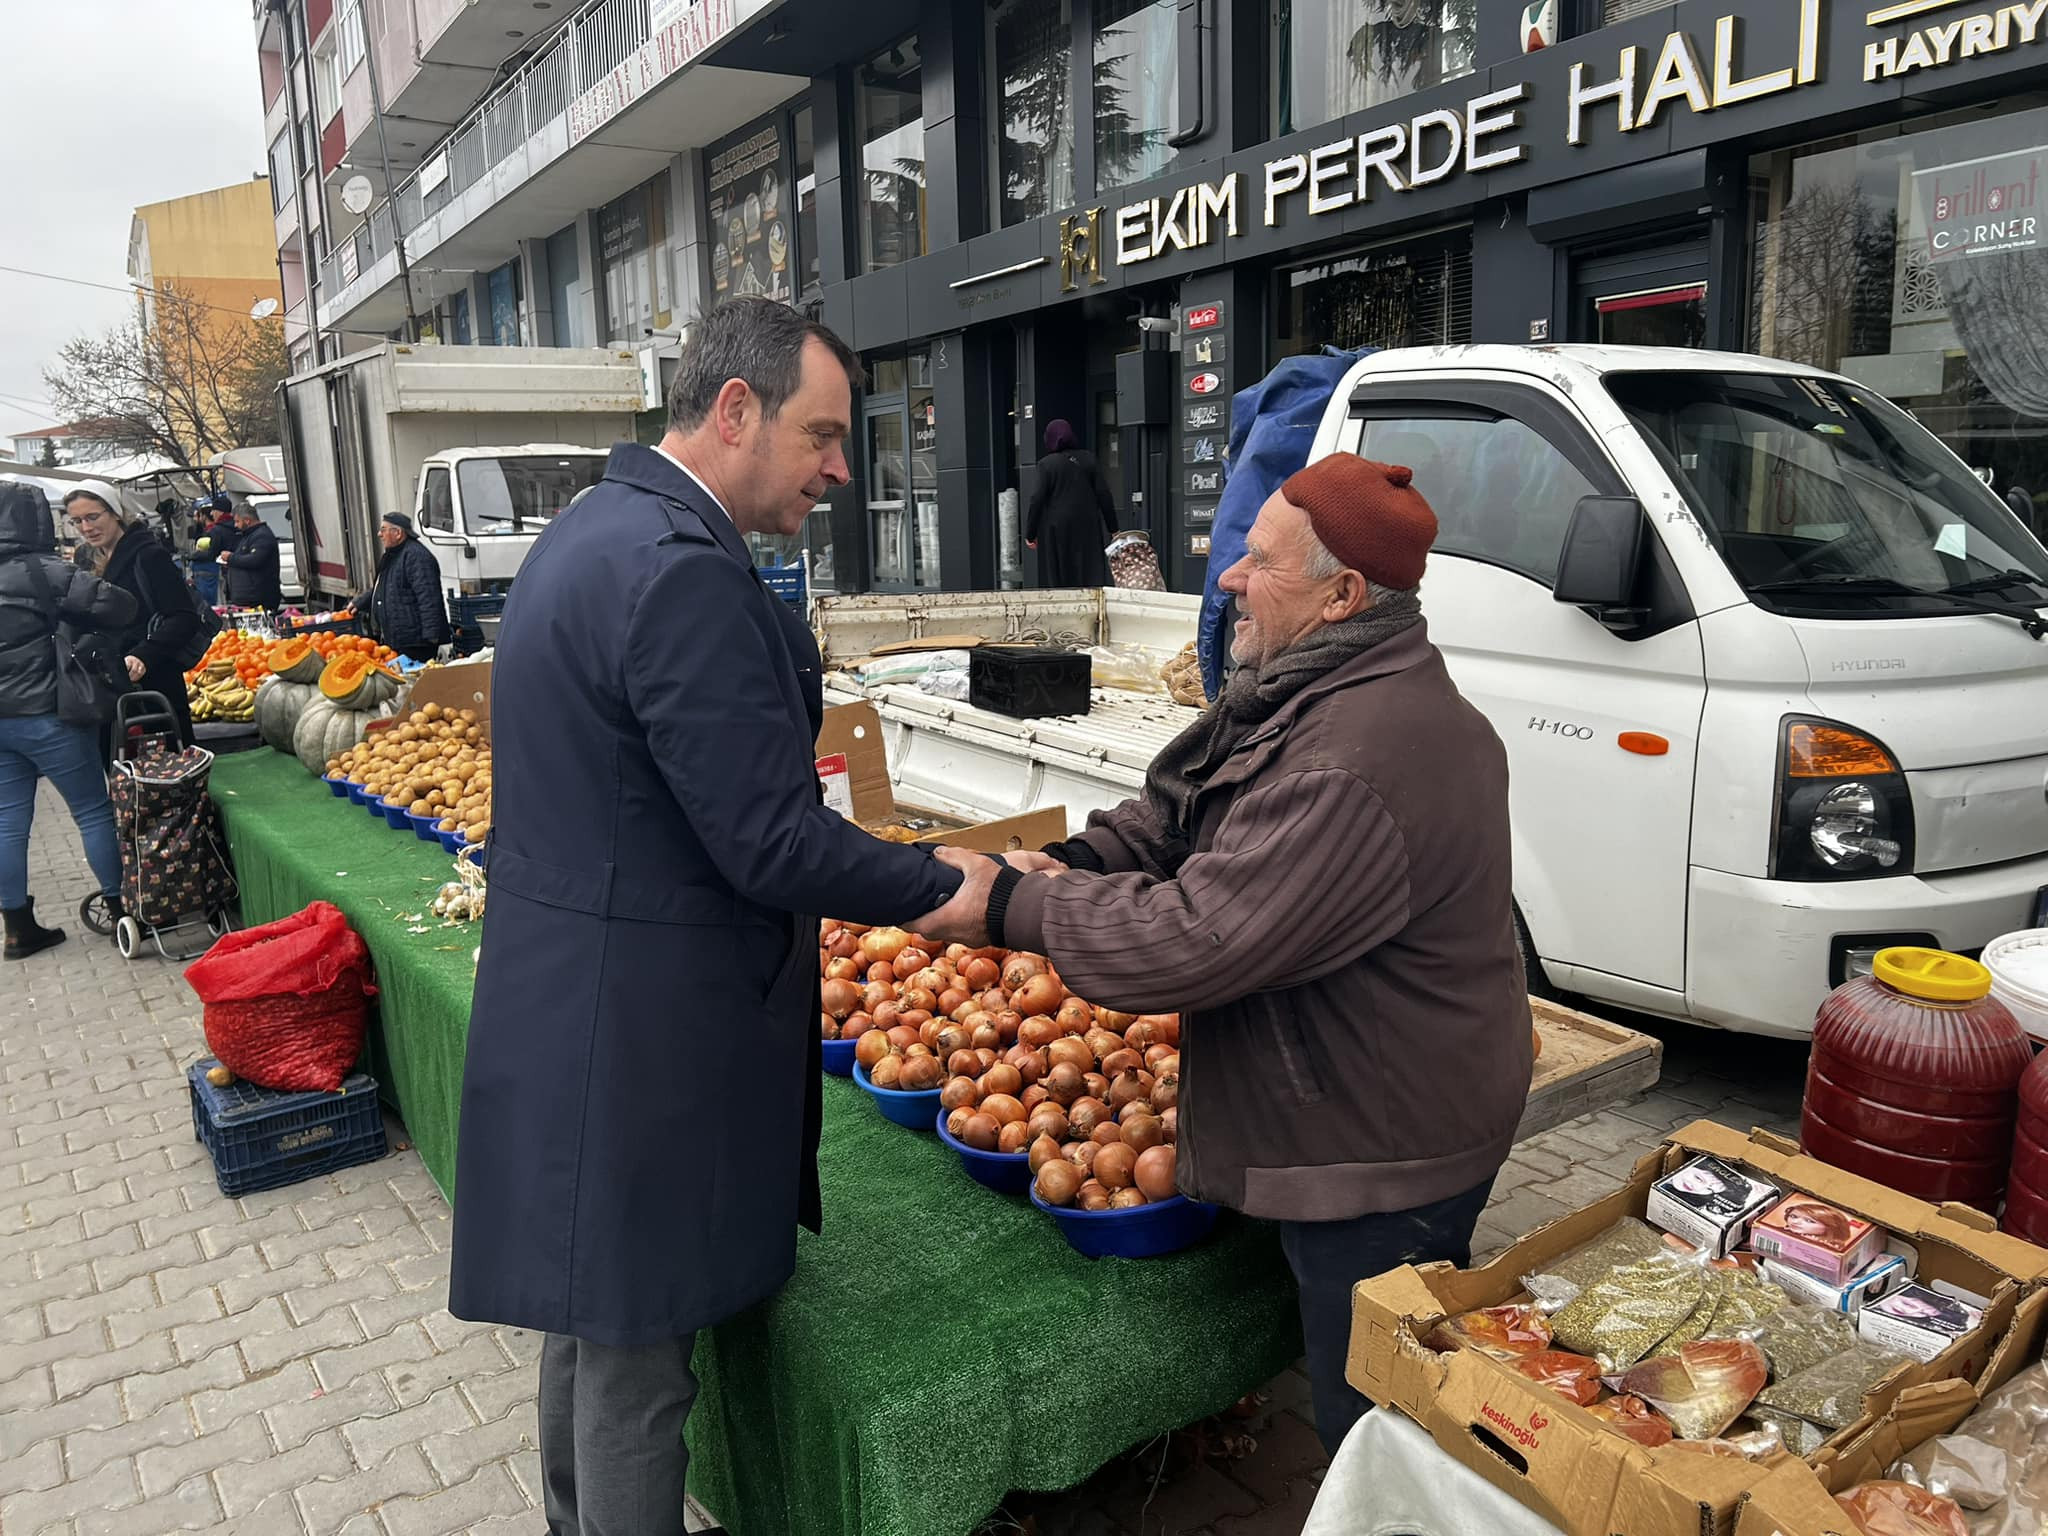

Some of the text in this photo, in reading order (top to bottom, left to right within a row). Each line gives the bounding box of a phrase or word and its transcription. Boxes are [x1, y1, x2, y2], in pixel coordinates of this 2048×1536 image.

[1863, 0, 2048, 82] HAYRIY
[1264, 82, 1527, 226] PERDE
[1567, 0, 1820, 145] HALI
[1934, 160, 2040, 223] brillant
[1933, 216, 2036, 249] CORNER
[1831, 658, 1905, 672] HYUNDAI
[1528, 717, 1594, 740] H-100
[1481, 1401, 1540, 1449] keskinoğlu
